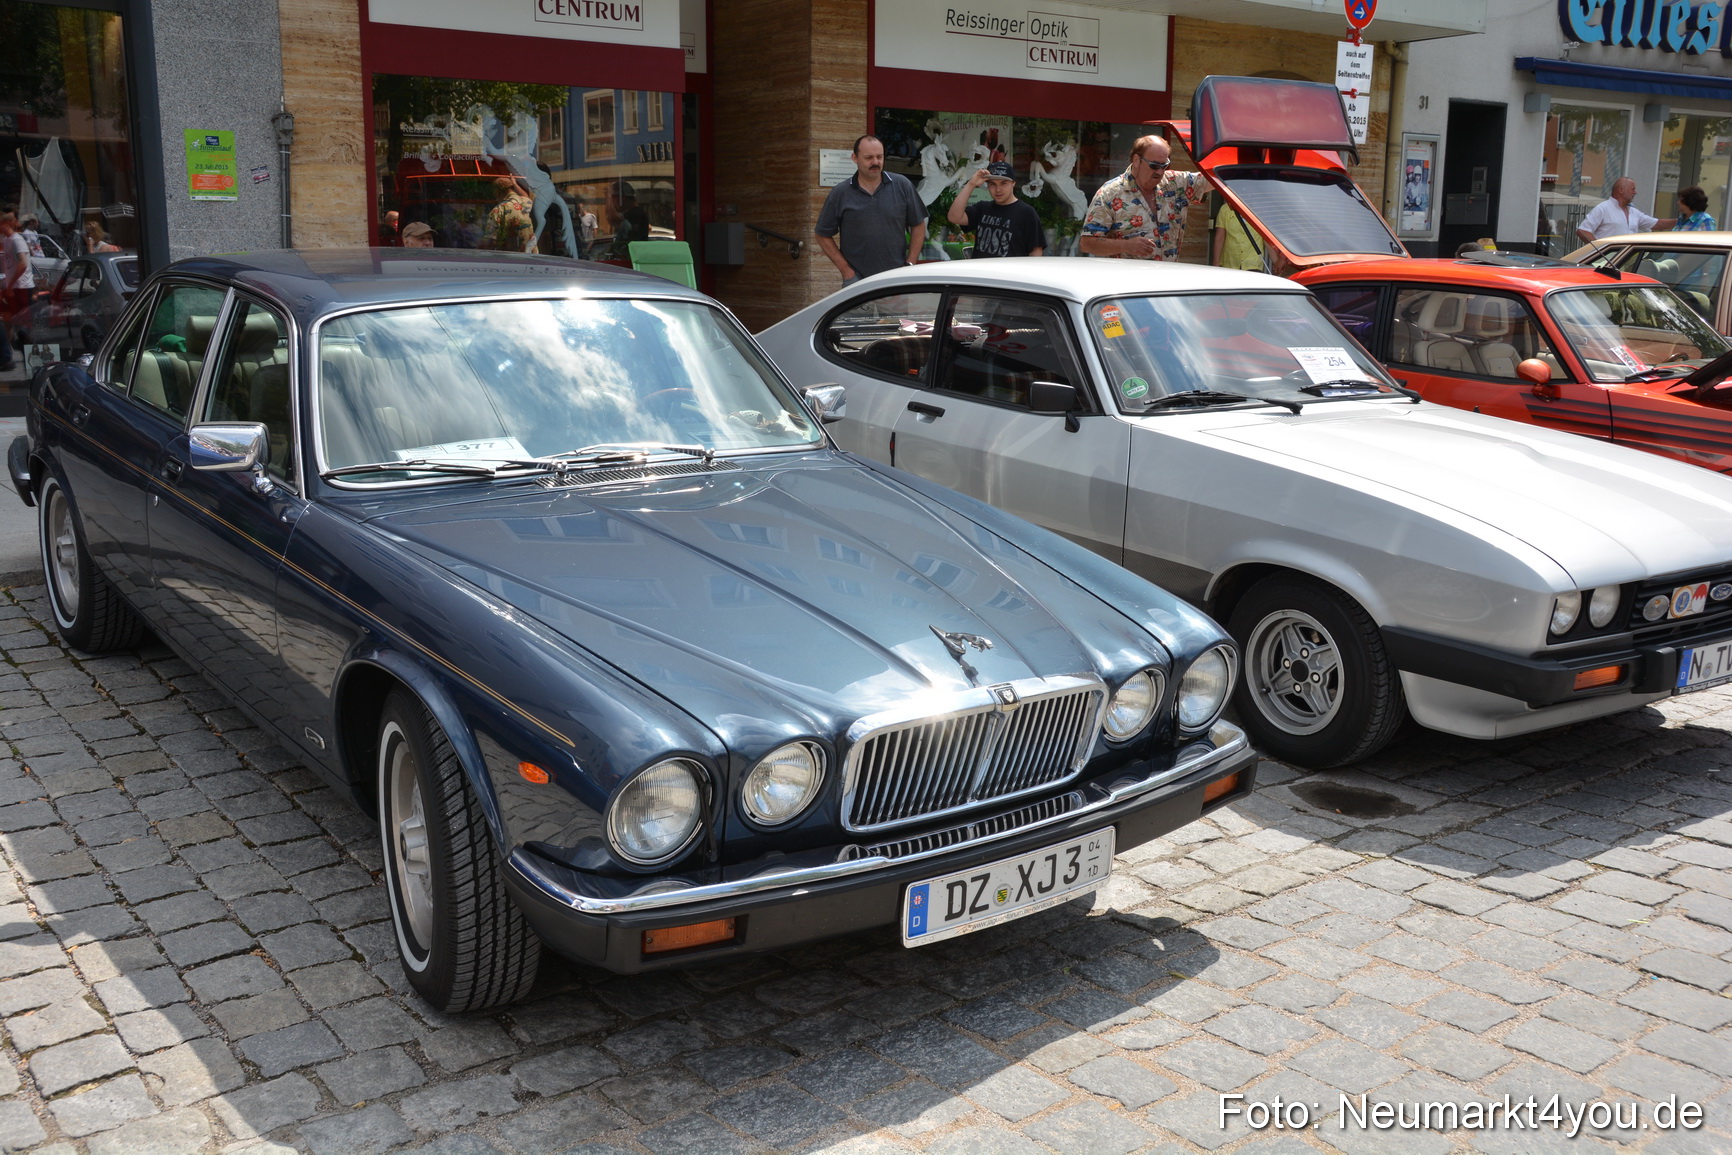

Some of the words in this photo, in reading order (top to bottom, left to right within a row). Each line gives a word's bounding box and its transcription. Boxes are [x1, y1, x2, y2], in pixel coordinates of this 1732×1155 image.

[538, 0, 640, 23] CENTRUM
[945, 8, 1025, 36] Reissinger
[1030, 18, 1069, 39] Optik
[1059, 38, 1068, 46] im
[1029, 46, 1097, 67] CENTRUM
[1337, 70, 1370, 80] Seitenstreifen
[1348, 103, 1356, 112] Ab
[1418, 95, 1429, 110] 31
[1353, 129, 1364, 138] Uhr
[439, 153, 488, 161] Contactlinse
[981, 214, 1002, 226] LIKE
[1102, 321, 1121, 331] ADAC
[1324, 356, 1346, 367] 254
[456, 442, 495, 451] 377
[1689, 650, 1705, 680] N
[1088, 839, 1100, 852] 04
[944, 872, 991, 922] DZ
[912, 915, 921, 928] D
